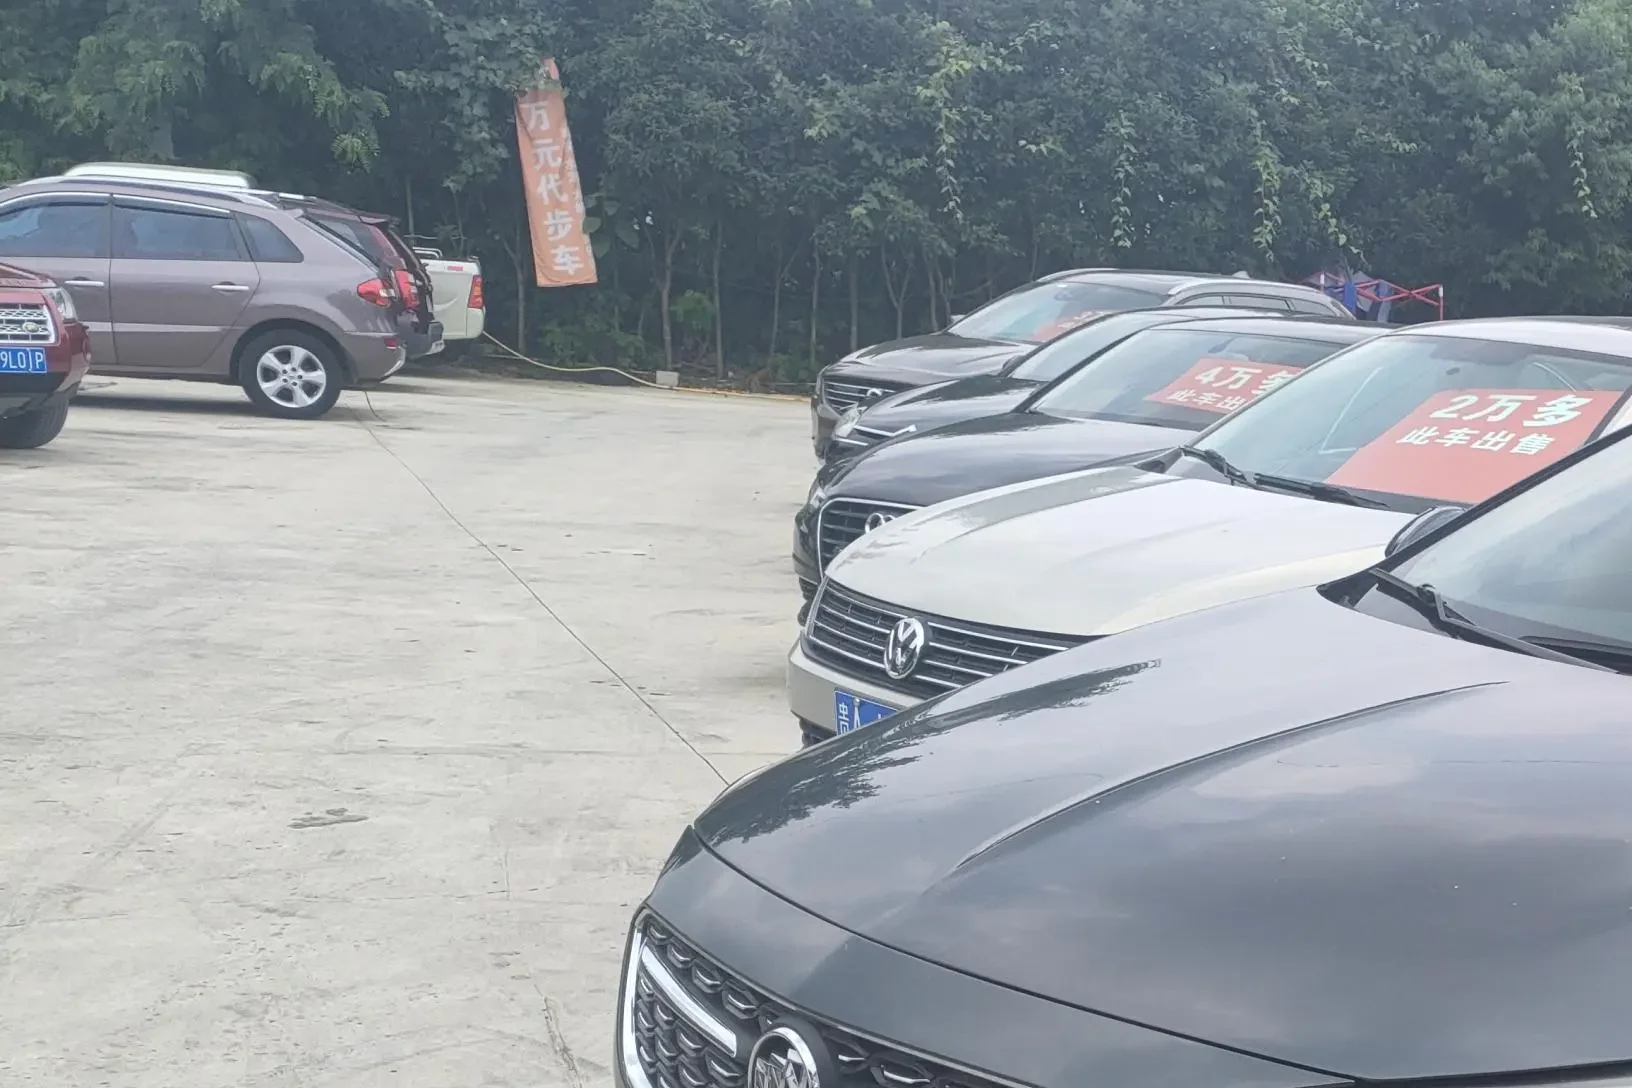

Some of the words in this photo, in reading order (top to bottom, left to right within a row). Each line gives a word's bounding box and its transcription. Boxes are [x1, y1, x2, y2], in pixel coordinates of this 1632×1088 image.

[1195, 366, 1296, 396] 4万多
[1429, 394, 1593, 427] 2万多
[1396, 426, 1556, 455] 此车出售
